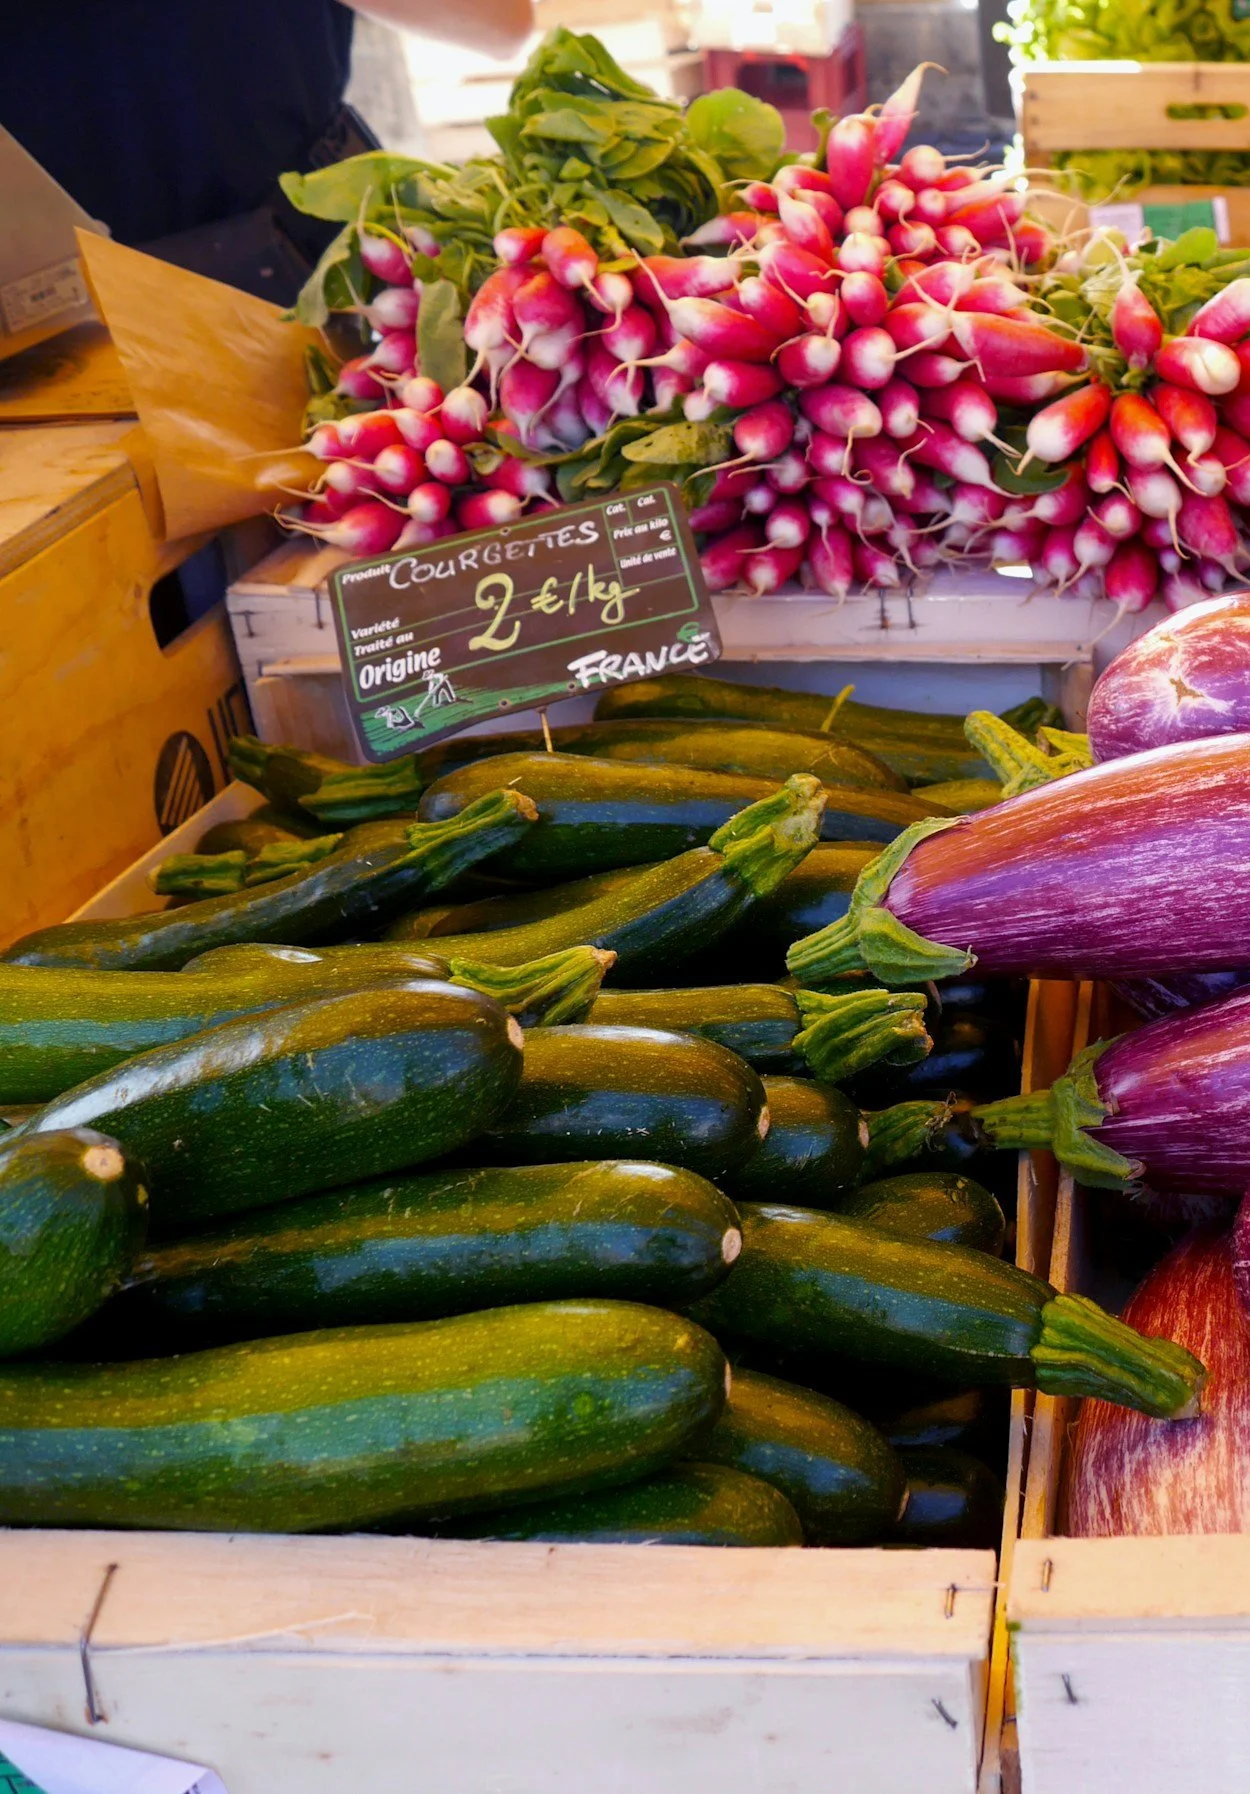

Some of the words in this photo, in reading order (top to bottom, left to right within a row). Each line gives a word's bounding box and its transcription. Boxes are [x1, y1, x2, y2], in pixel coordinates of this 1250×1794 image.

[607, 503, 626, 515] Cat.
[637, 494, 656, 507] Cat.
[614, 526, 633, 539] Prix
[634, 523, 648, 534] au
[649, 518, 669, 530] kilo
[659, 530, 672, 541] €
[619, 555, 642, 569] Unité
[642, 552, 653, 564] de
[653, 547, 676, 561] vente
[342, 564, 391, 585] Produit
[468, 572, 522, 651] 2
[350, 616, 400, 640] Variété
[354, 634, 394, 656] Traité
[395, 631, 415, 645] au
[359, 647, 442, 690] Origine
[567, 631, 711, 689] FRANCE
